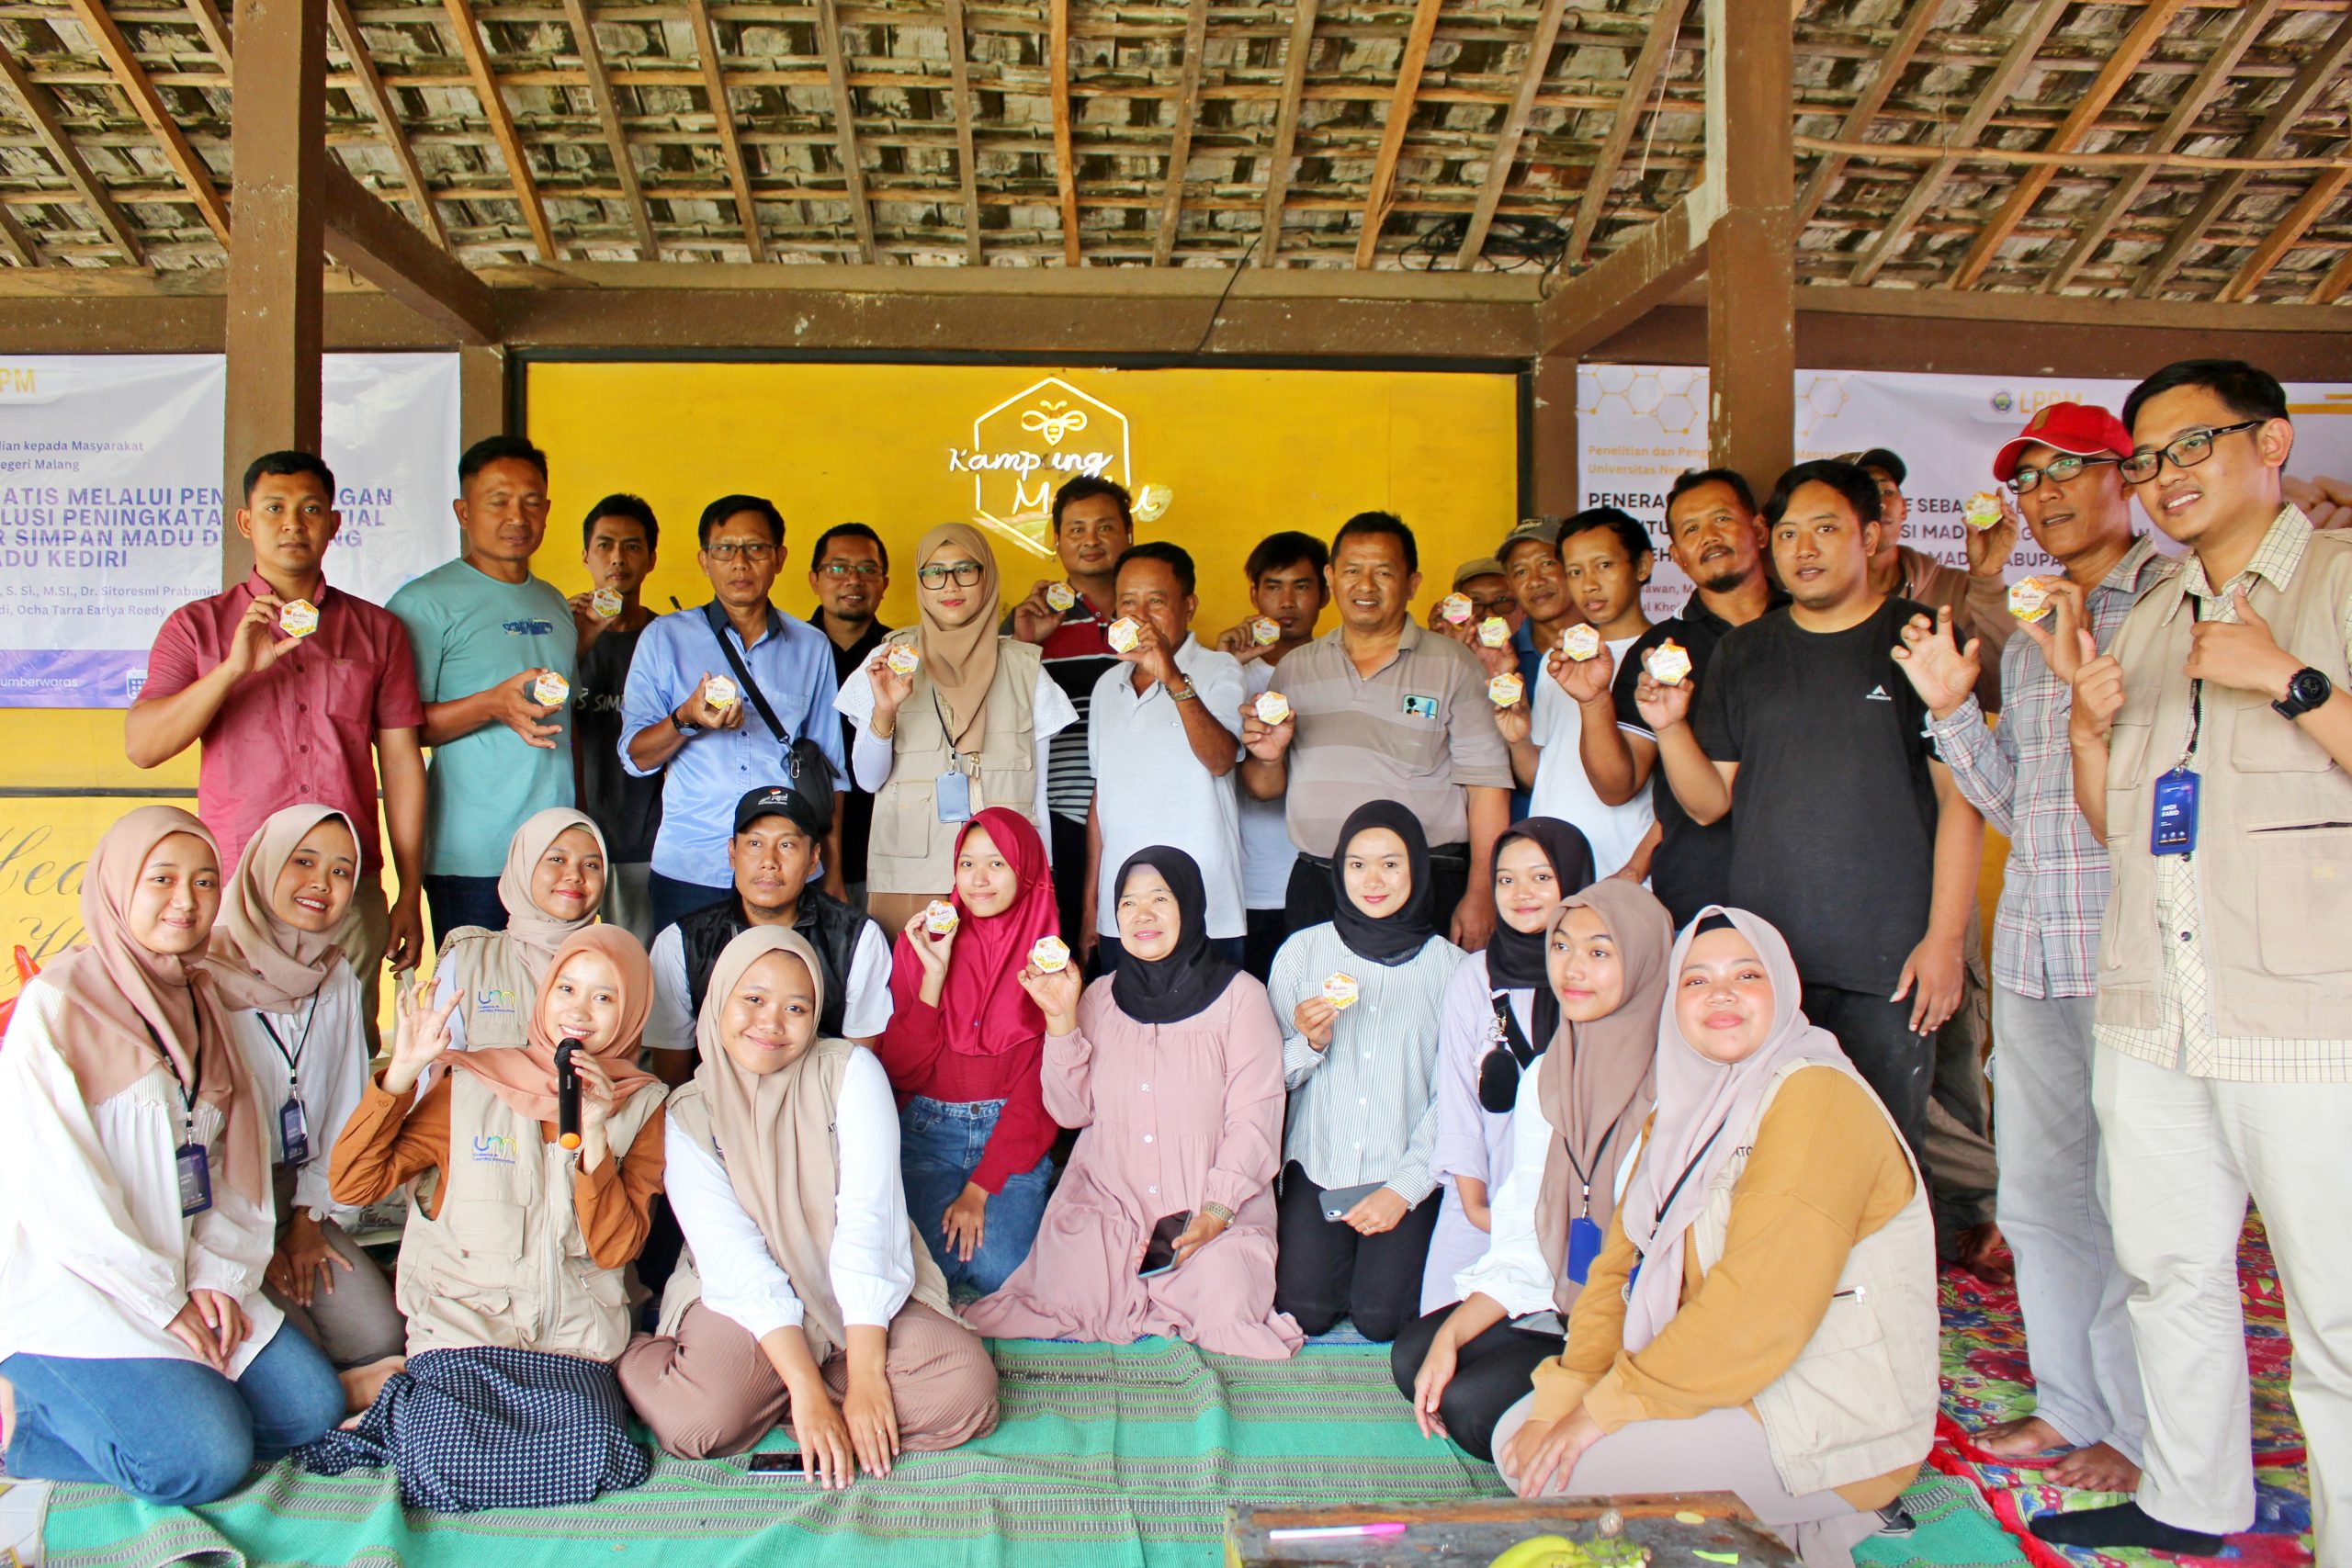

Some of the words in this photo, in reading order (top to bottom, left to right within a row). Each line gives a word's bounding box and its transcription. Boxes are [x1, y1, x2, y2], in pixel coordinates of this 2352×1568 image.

[24, 441, 68, 453] kepada
[72, 441, 144, 453] Masyarakat
[1588, 446, 1648, 457] Penelitian
[1653, 446, 1675, 457] dan
[35, 459, 80, 472] Malang
[1588, 465, 1655, 475] Universitas
[4, 488, 59, 505] ATIS
[68, 488, 172, 505] MELALUI
[1589, 493, 1666, 508] PENERA
[1918, 498, 1963, 513] SEBA
[15, 529, 112, 547] SIMPAN
[121, 529, 194, 547] MADU
[1923, 525, 1965, 539] MAD
[0, 550, 38, 567] DU
[48, 550, 127, 567] KEDIRI
[81, 585, 97, 596] Dr.
[101, 585, 159, 596] Sitoresmi
[164, 585, 221, 596] Prabanin
[17, 604, 49, 615] Ocha
[52, 604, 84, 615] Tarra
[128, 604, 166, 617] Roedy
